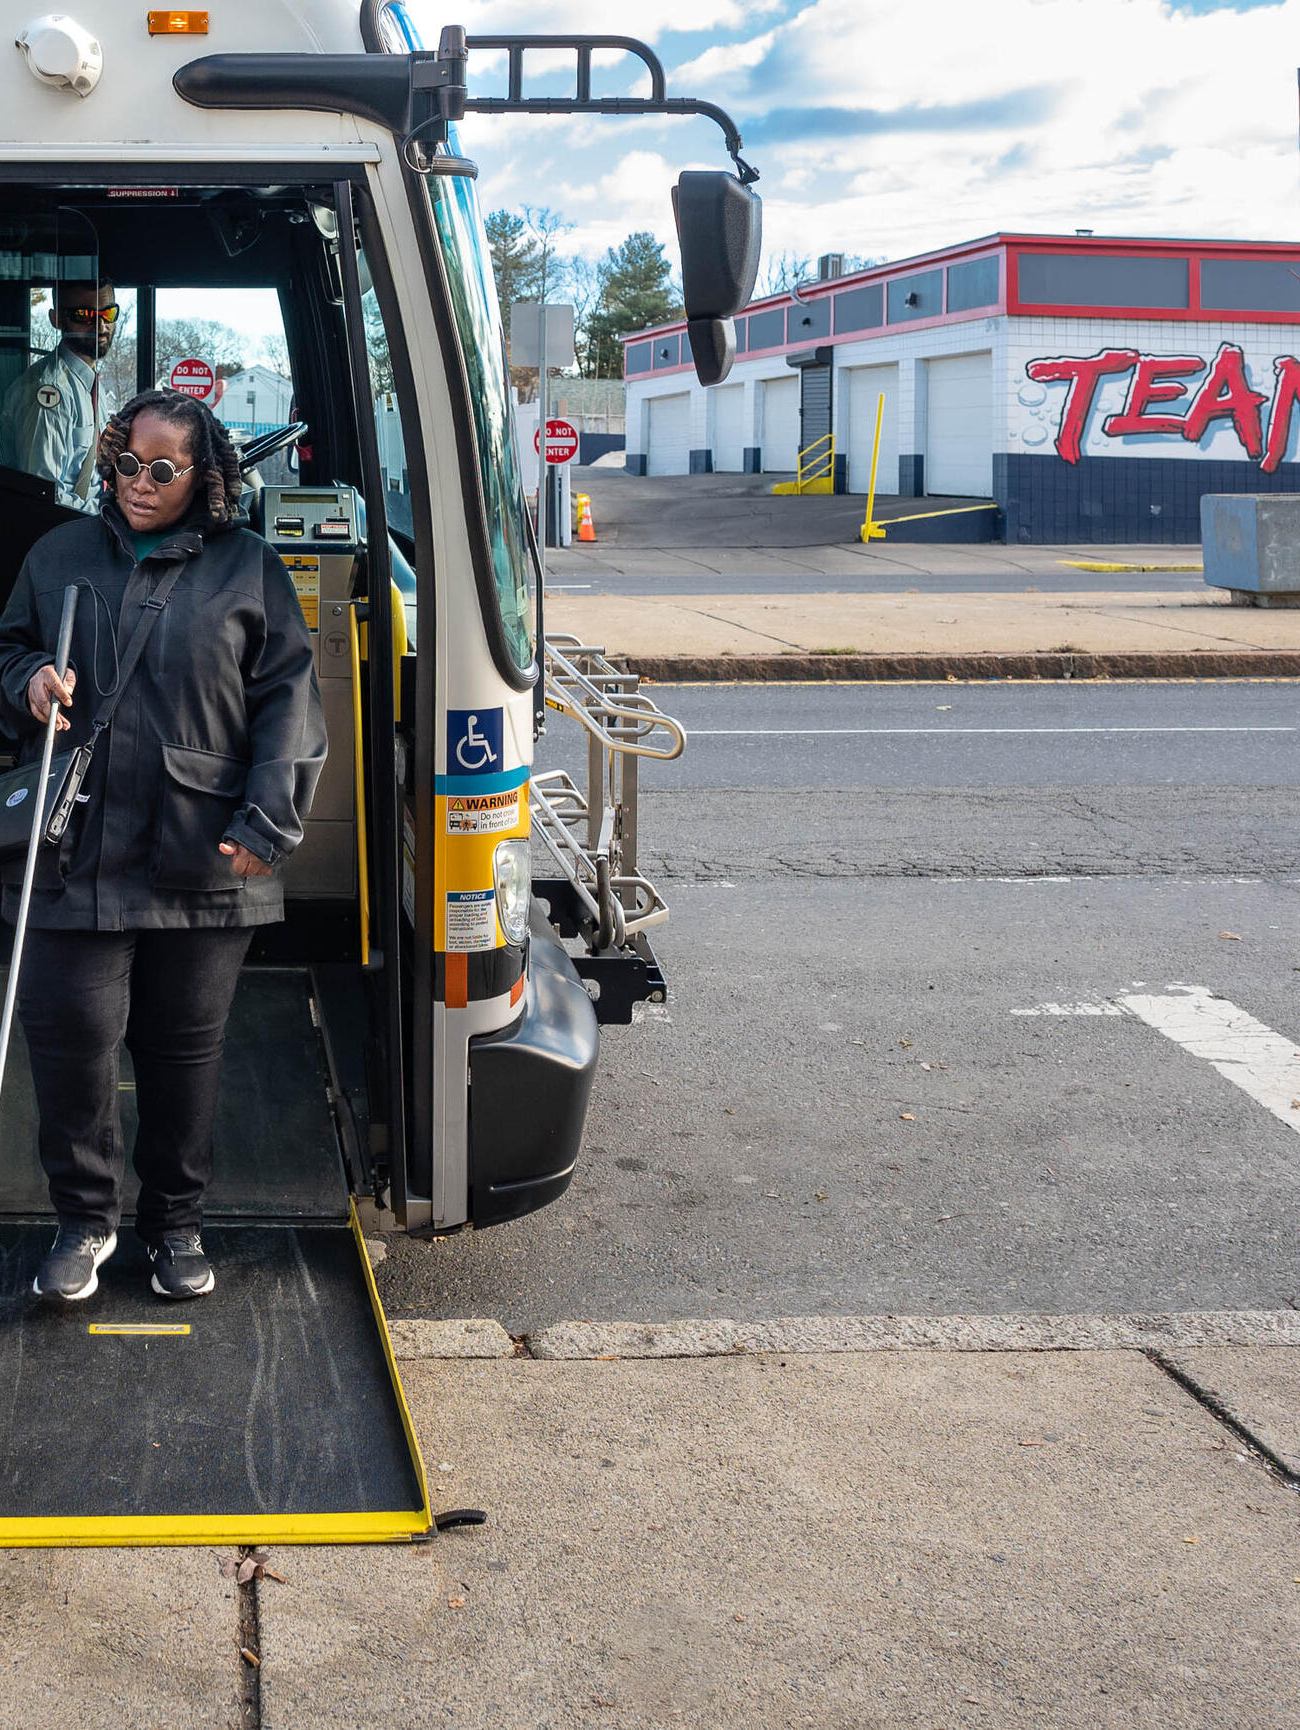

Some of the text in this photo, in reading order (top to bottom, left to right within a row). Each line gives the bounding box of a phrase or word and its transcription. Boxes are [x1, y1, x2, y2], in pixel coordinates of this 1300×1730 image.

[176, 366, 209, 375] DO NOT
[178, 386, 205, 395] ENTER
[40, 391, 55, 404] T
[555, 427, 572, 436] NOT
[329, 638, 346, 653] T
[466, 791, 518, 810] WARNING
[480, 812, 491, 821] Do
[492, 811, 503, 819] not
[488, 820, 504, 829] front
[459, 892, 487, 901] NOTICE
